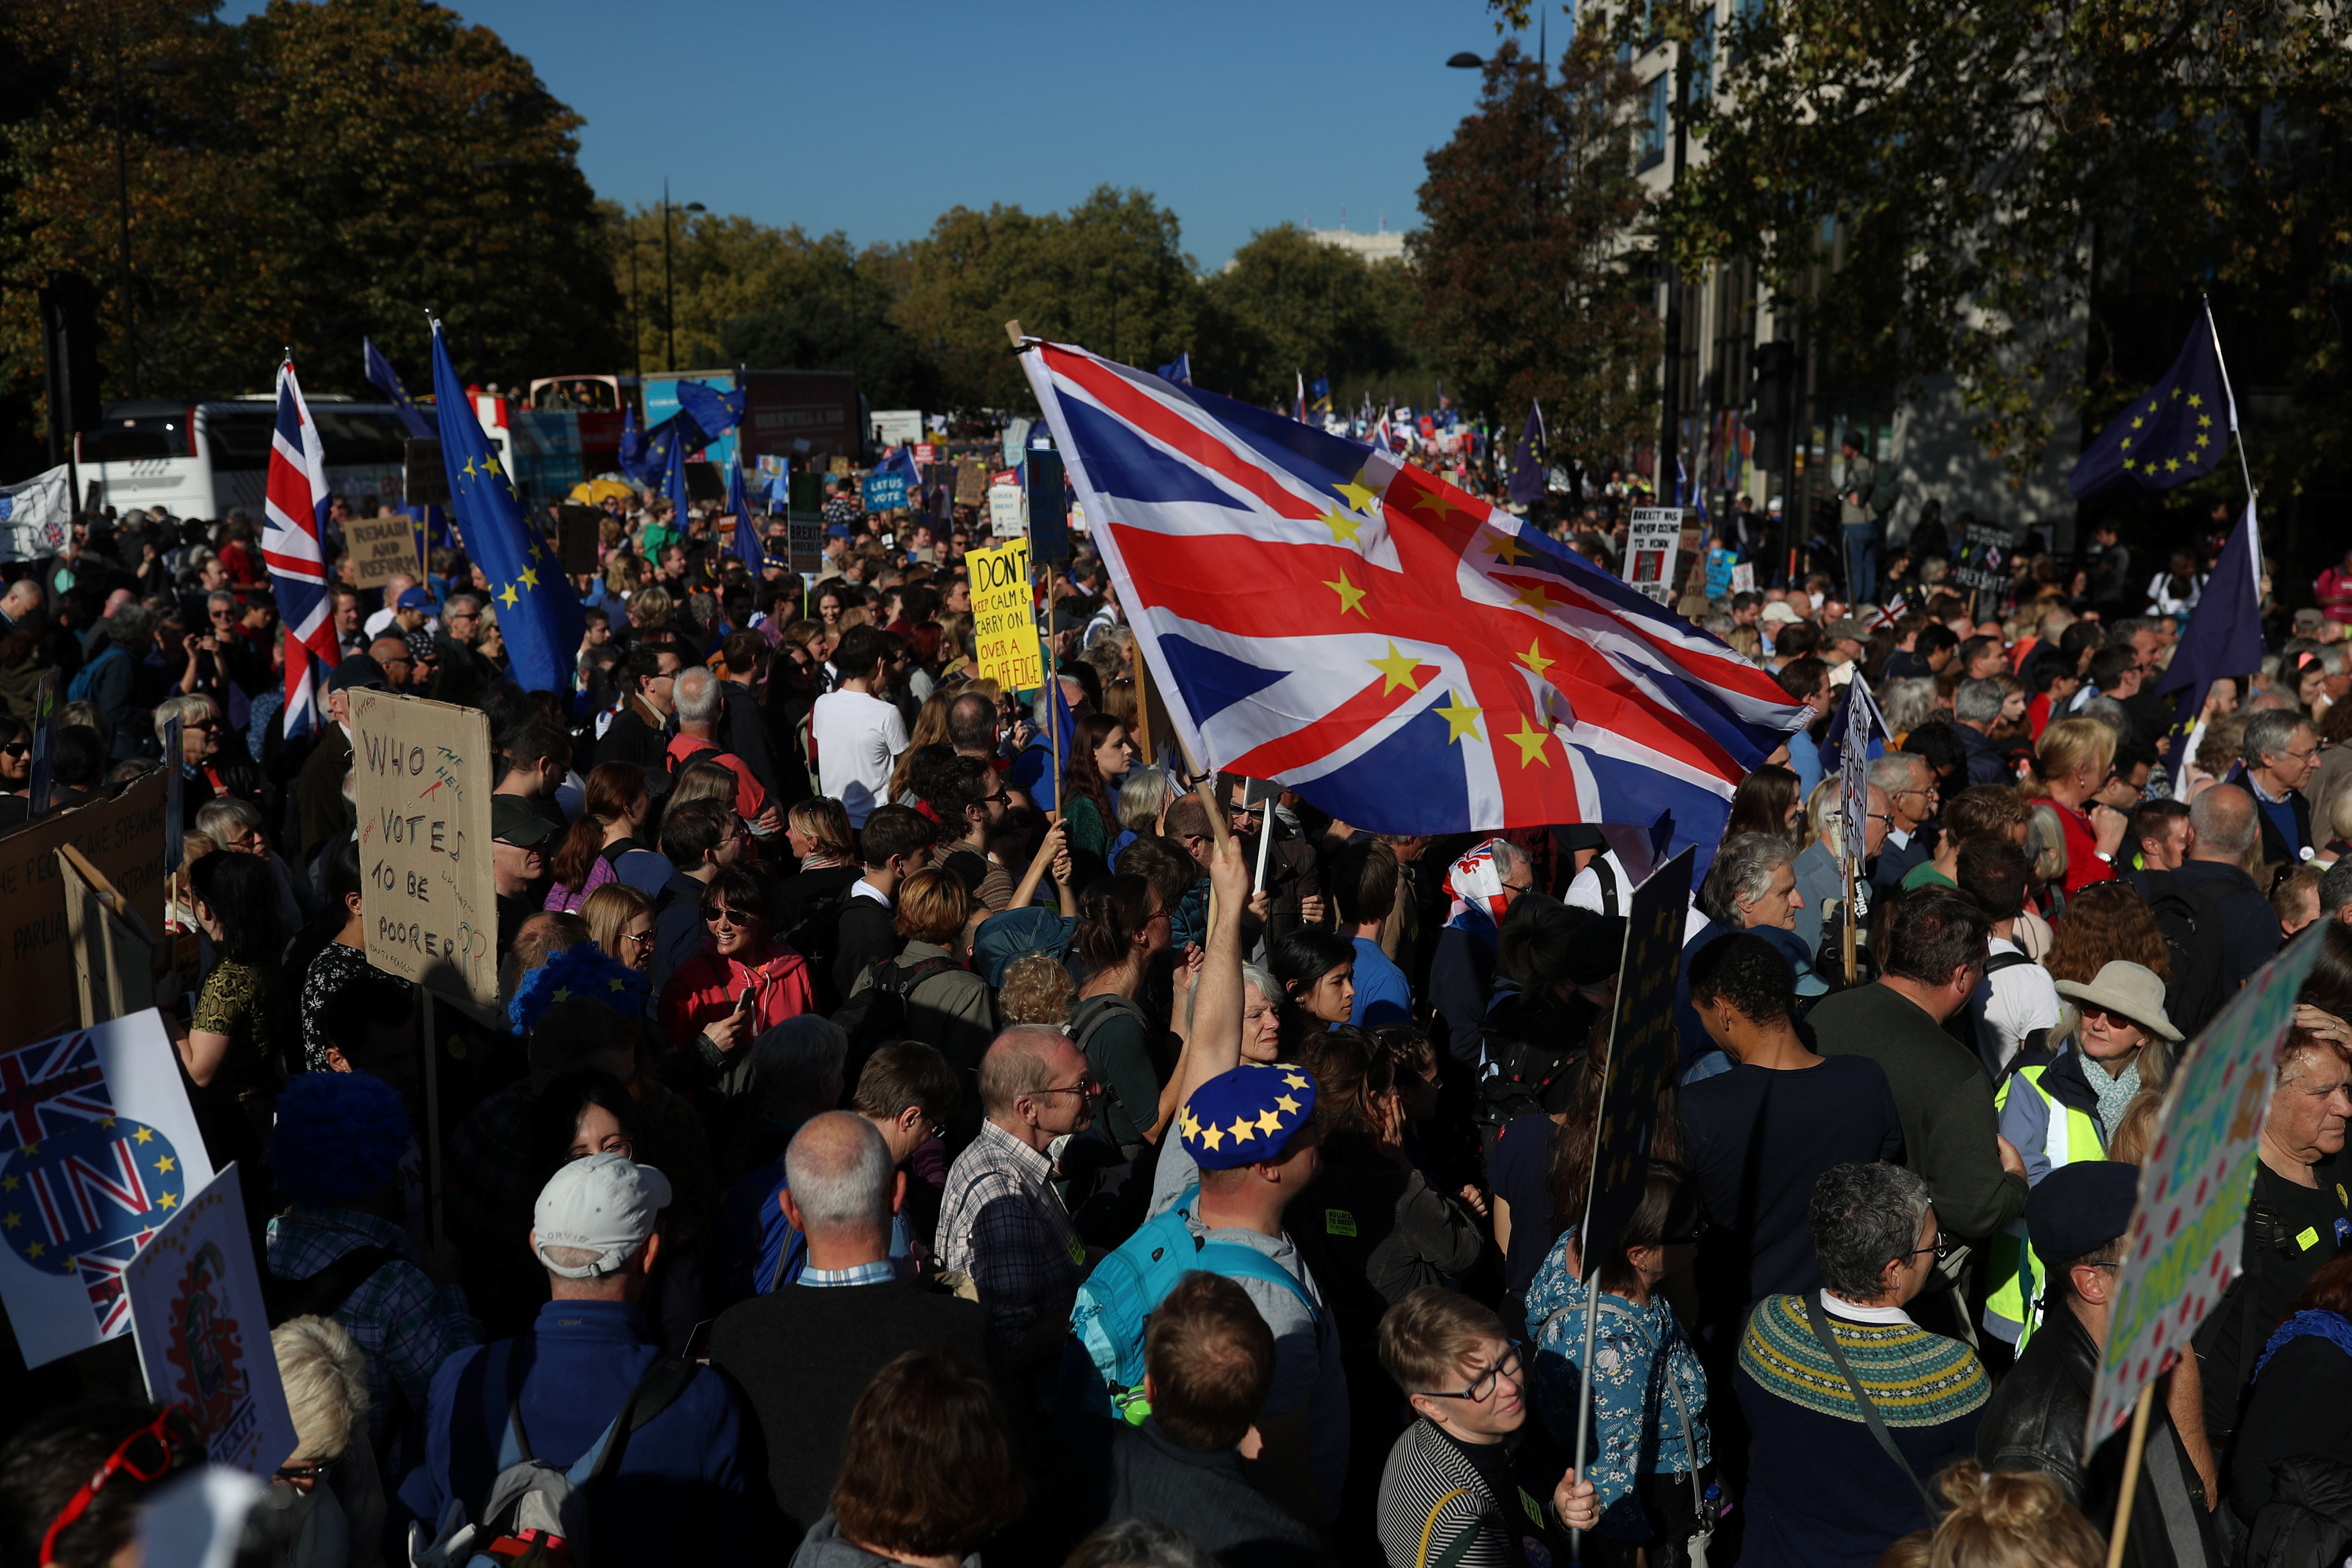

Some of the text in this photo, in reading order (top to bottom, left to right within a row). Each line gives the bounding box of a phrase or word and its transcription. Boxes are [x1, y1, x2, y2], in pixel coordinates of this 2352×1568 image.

[871, 478, 904, 492] LET US
[872, 490, 900, 504] VOTE
[1634, 510, 1662, 520] BREXIT
[353, 522, 409, 543] REMAIN
[790, 525, 821, 541] BREXIT
[1634, 523, 1656, 533] NEVER
[372, 541, 400, 558] AND
[791, 541, 821, 552] WRECKS IT
[1634, 539, 1644, 548] TO
[358, 555, 419, 578] REFORM
[978, 548, 1027, 592] DON'T
[973, 588, 1027, 614] KEEP CALM &
[975, 613, 1003, 636] CARRY
[980, 638, 1021, 660] OVER A
[1013, 654, 1040, 686] EDGE
[362, 729, 425, 776] WHO
[437, 746, 464, 768] THE
[435, 766, 464, 801] HELL
[380, 806, 466, 863] VOTES
[0, 865, 17, 895] HE
[87, 825, 110, 859] ARE
[115, 802, 163, 849] SPEAKING
[371, 859, 431, 904] TO BE
[1855, 881, 1868, 916] Wilson
[27, 1137, 152, 1247] IN
[1337, 1219, 1355, 1227] BREXIT
[547, 1232, 587, 1244] ORVIS
